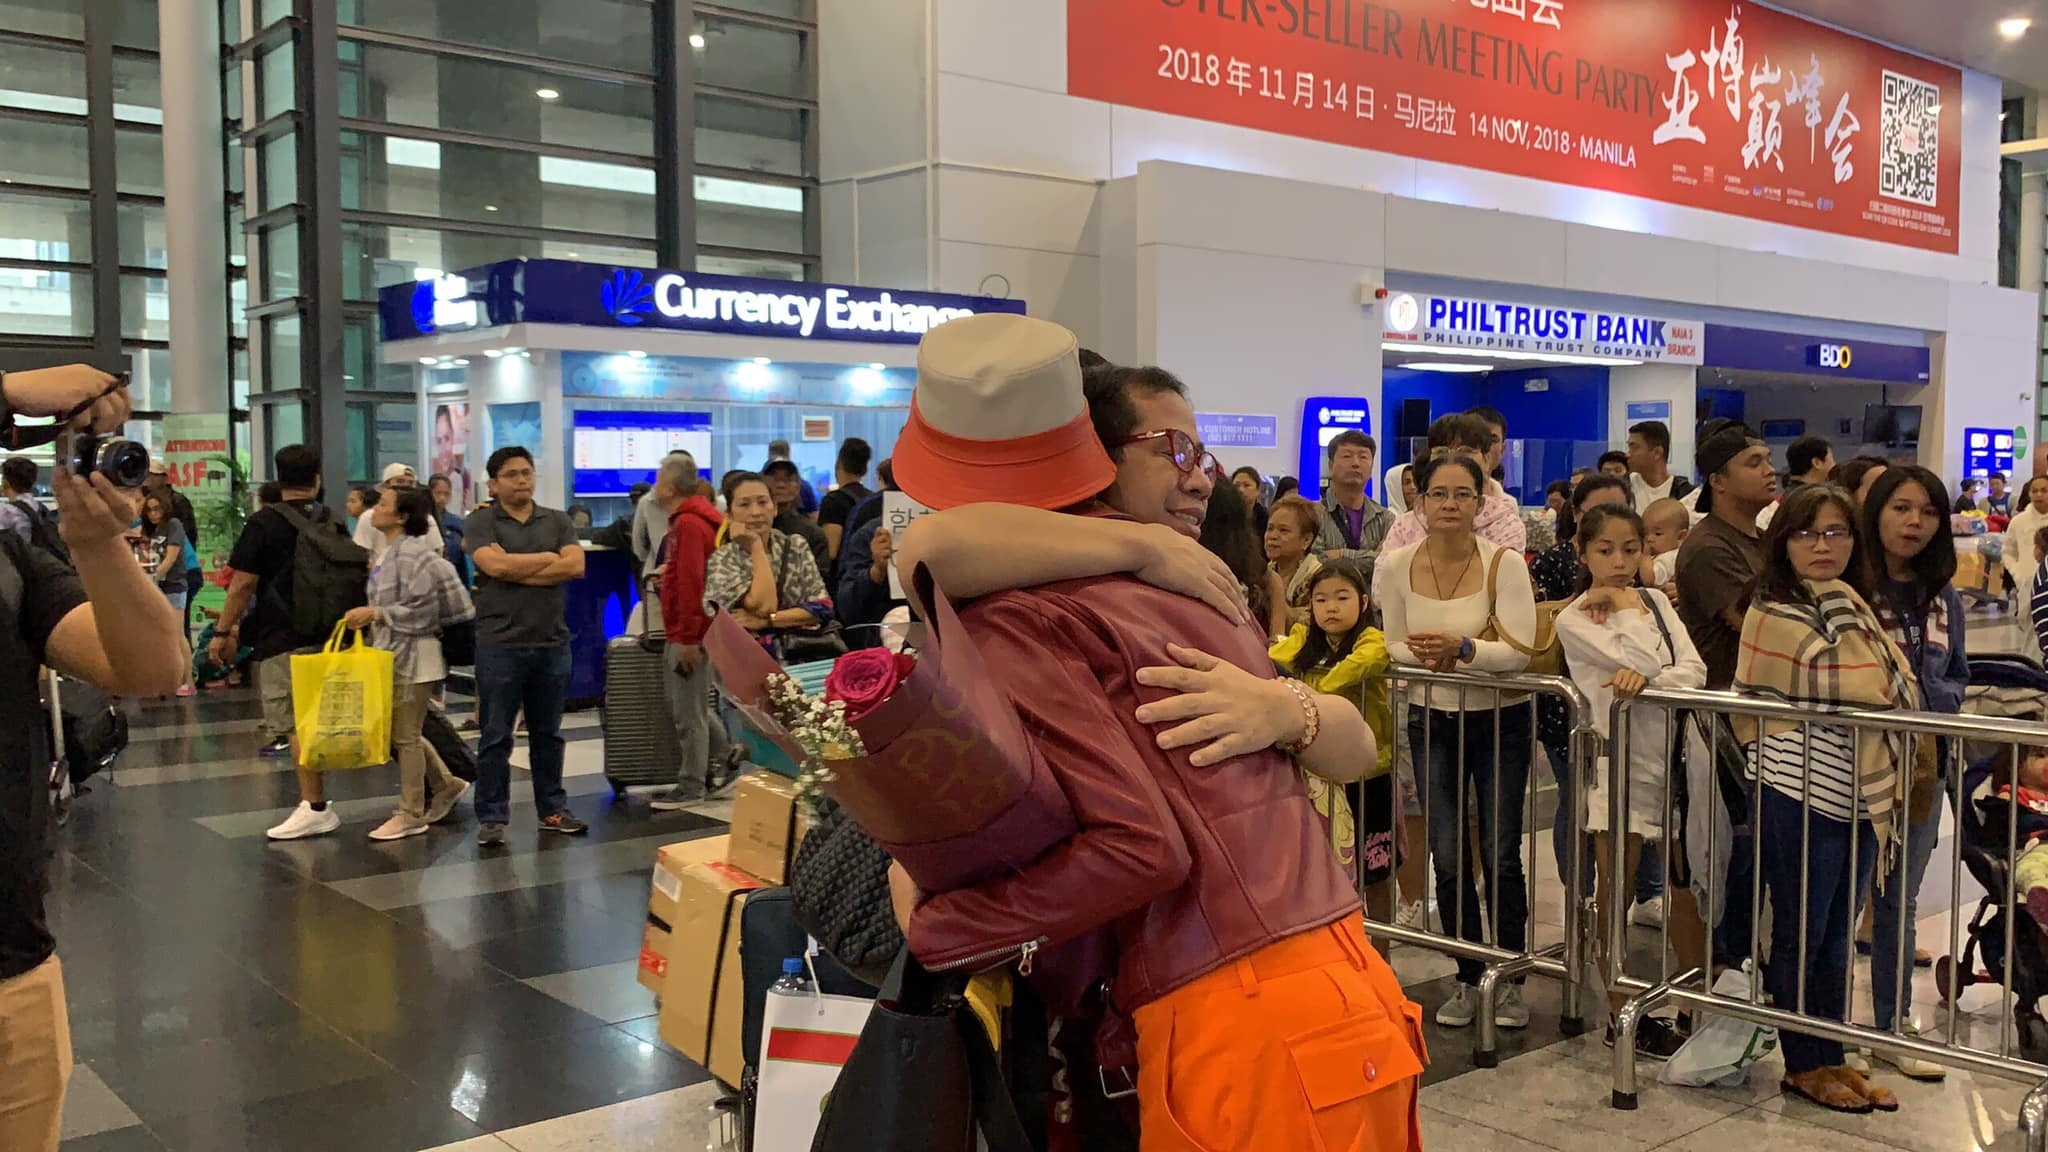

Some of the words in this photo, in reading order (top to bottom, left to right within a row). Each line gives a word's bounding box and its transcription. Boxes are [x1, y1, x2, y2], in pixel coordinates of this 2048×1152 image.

[1416, 17, 1564, 96] MEETING
[1575, 58, 1660, 119] PARTY
[1469, 112, 1489, 139] 14
[1579, 135, 1637, 169] MANILA
[654, 273, 821, 337] Currency
[825, 287, 974, 335] Exchan
[1427, 297, 1588, 341] PHILTRUST
[1595, 313, 1667, 348] BANK
[1423, 332, 1525, 349] PHILIPPINE
[1535, 340, 1584, 353] TRUST
[1593, 345, 1661, 359] COMPANY
[1820, 343, 1852, 369] BDO
[167, 460, 208, 488] ASF
